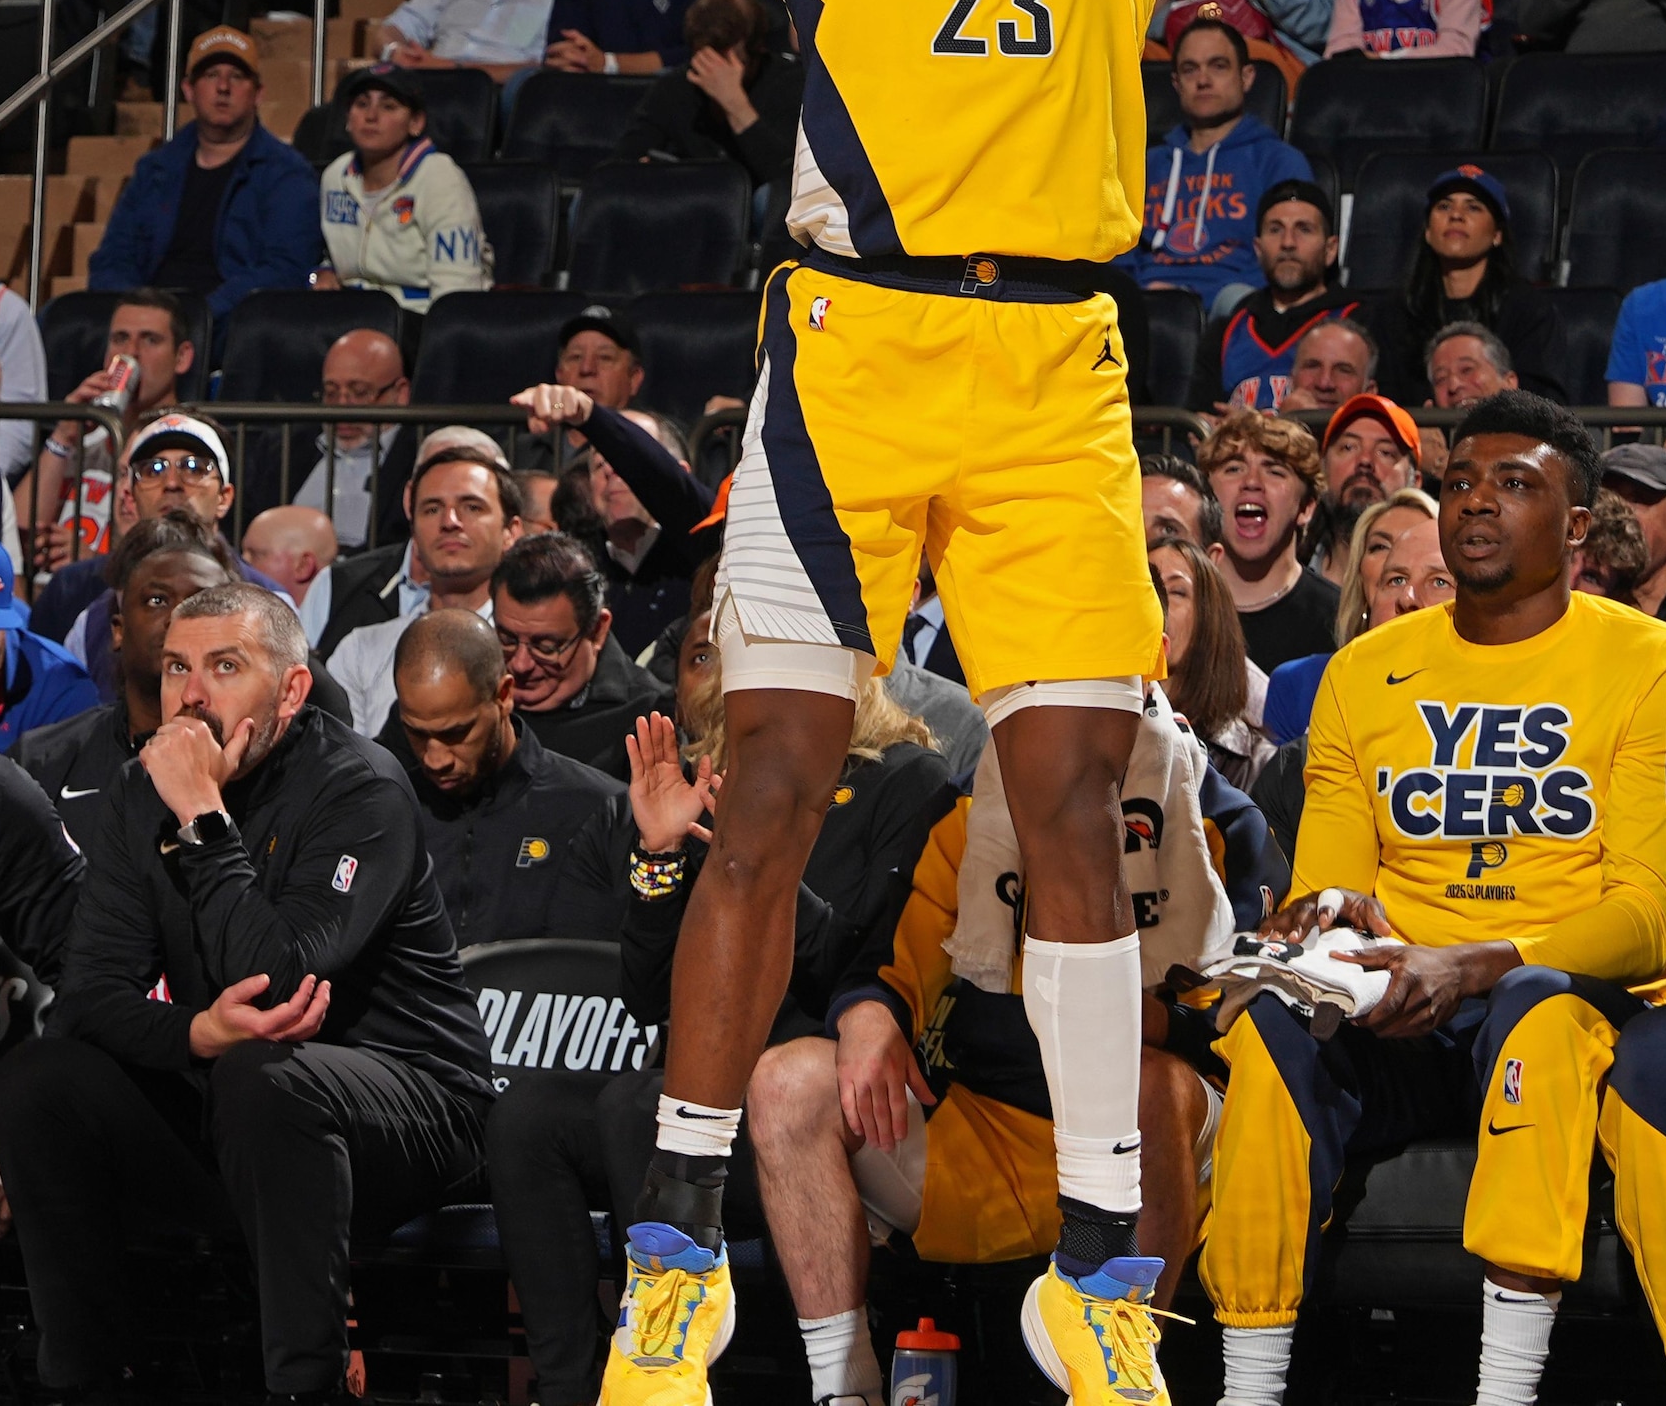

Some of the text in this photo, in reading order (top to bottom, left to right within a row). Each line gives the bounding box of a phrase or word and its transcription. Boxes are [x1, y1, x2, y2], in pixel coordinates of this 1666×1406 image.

[1418, 699, 1573, 771] YES
[1378, 766, 1597, 842] 'CERS
[1444, 883, 1516, 901] 2025 PLAYOFFS
